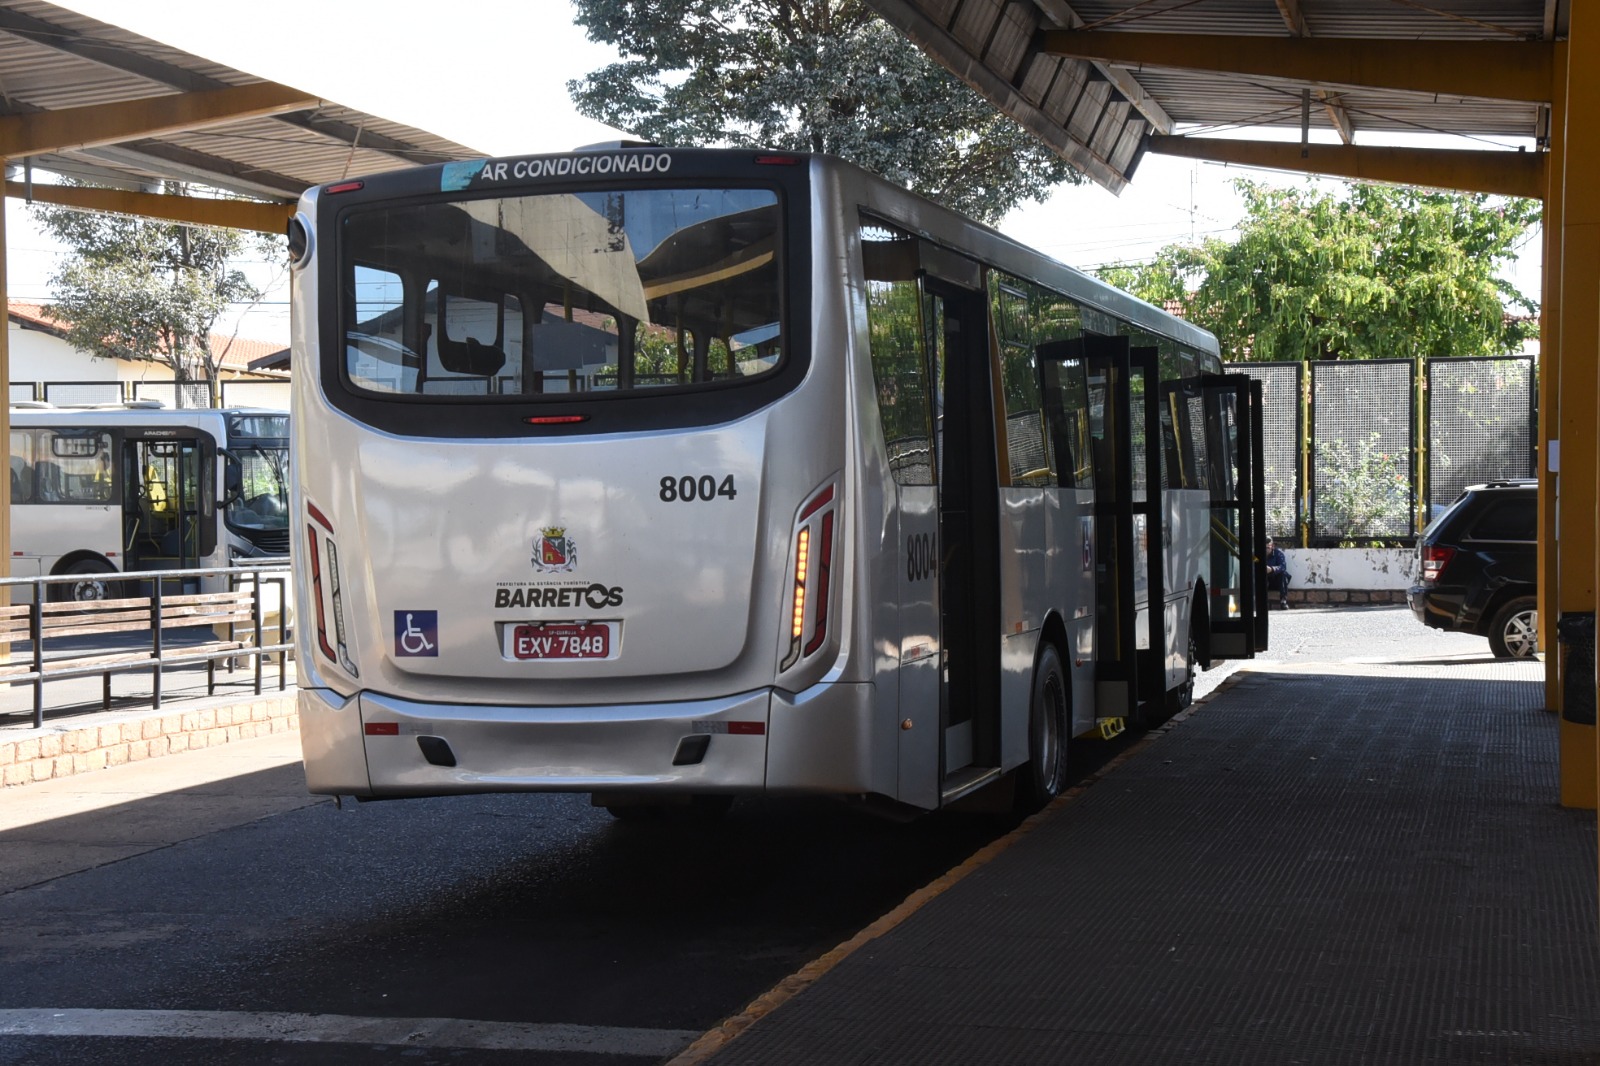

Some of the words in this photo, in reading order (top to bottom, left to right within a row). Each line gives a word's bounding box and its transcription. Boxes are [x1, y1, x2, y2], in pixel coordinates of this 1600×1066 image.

[481, 163, 508, 182] AR
[513, 153, 672, 179] CONDICIONADO
[659, 474, 738, 502] 8004
[907, 531, 937, 583] 8004
[494, 583, 624, 609] BARRETOS
